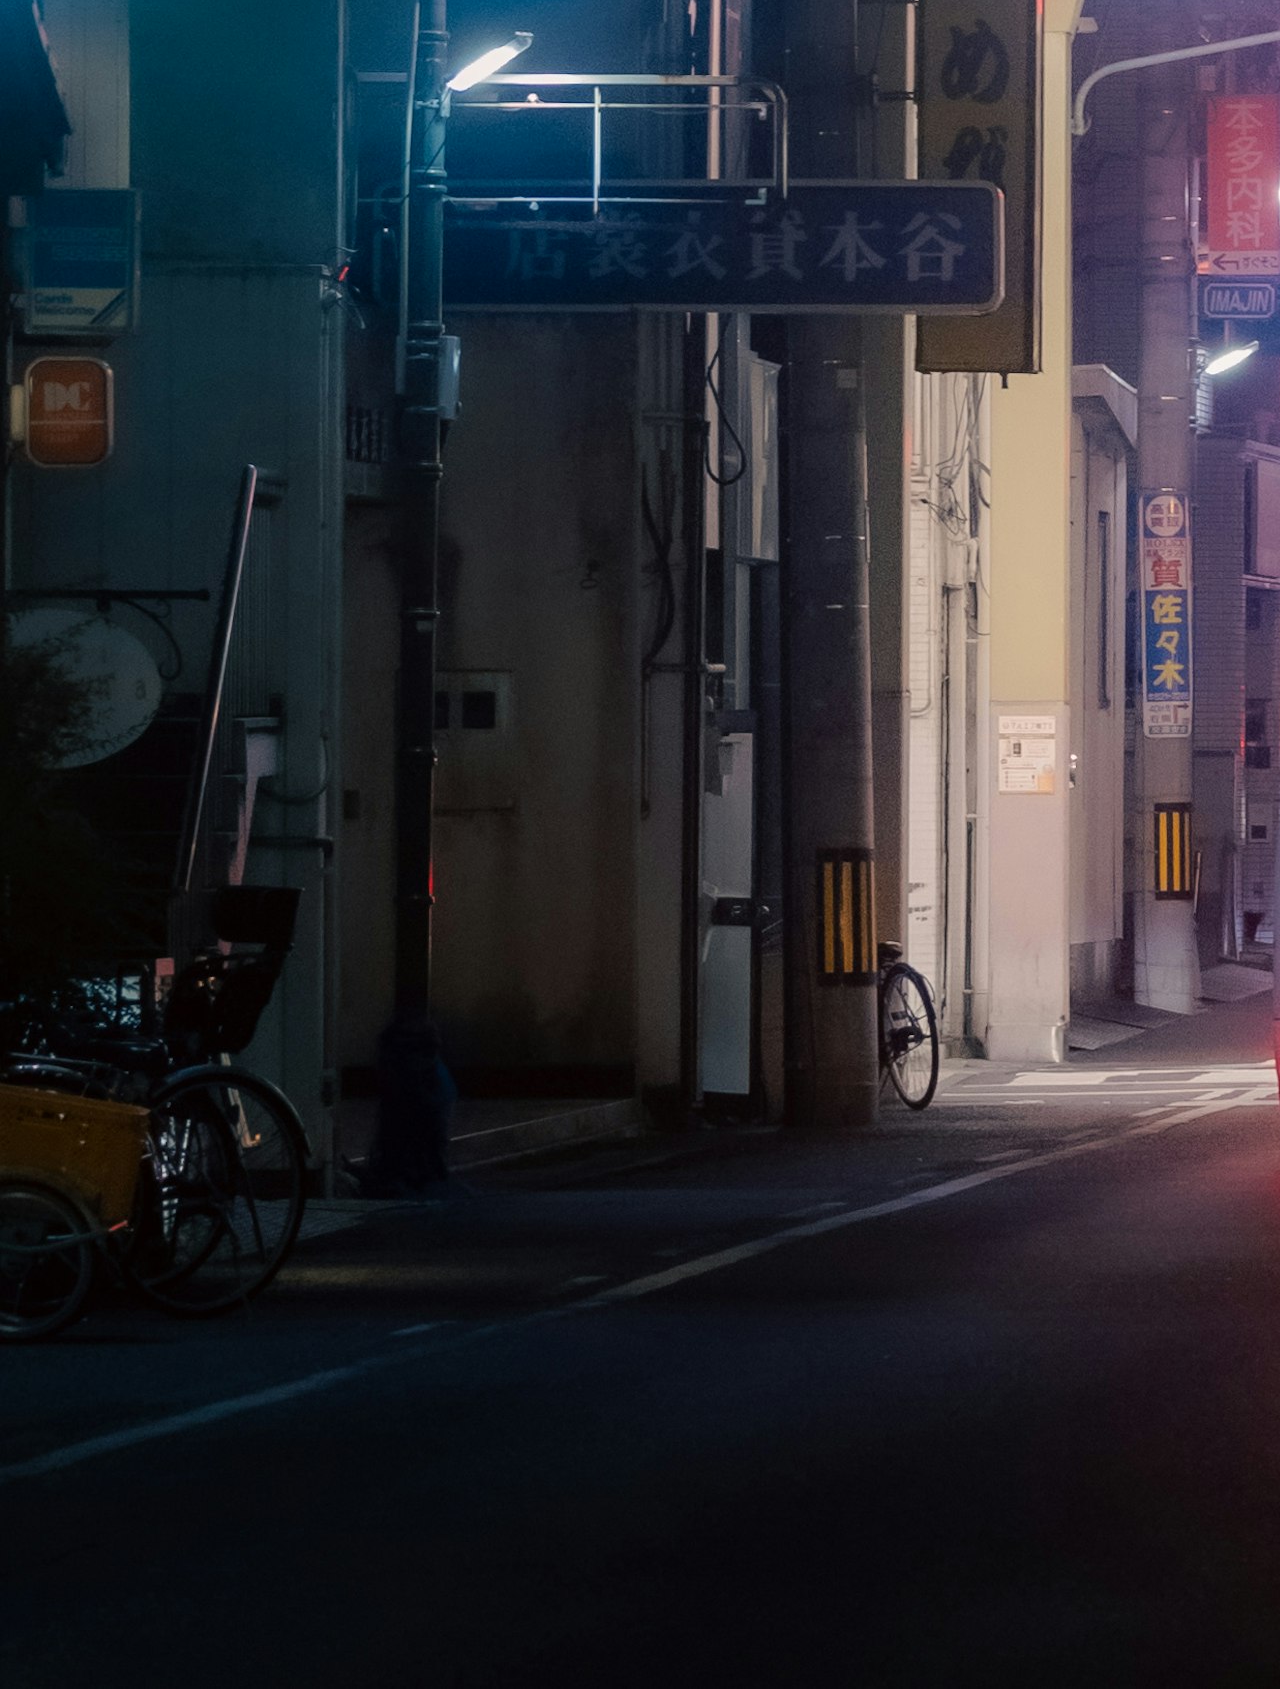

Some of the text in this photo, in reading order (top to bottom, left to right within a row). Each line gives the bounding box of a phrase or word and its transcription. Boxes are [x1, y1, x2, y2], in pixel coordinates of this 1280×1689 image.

[1225, 99, 1265, 249] 本多内科
[1210, 295, 1270, 313] IMAJIN
[43, 381, 91, 412] DC
[1150, 559, 1182, 588] 質
[1151, 593, 1185, 691] 佐々木
